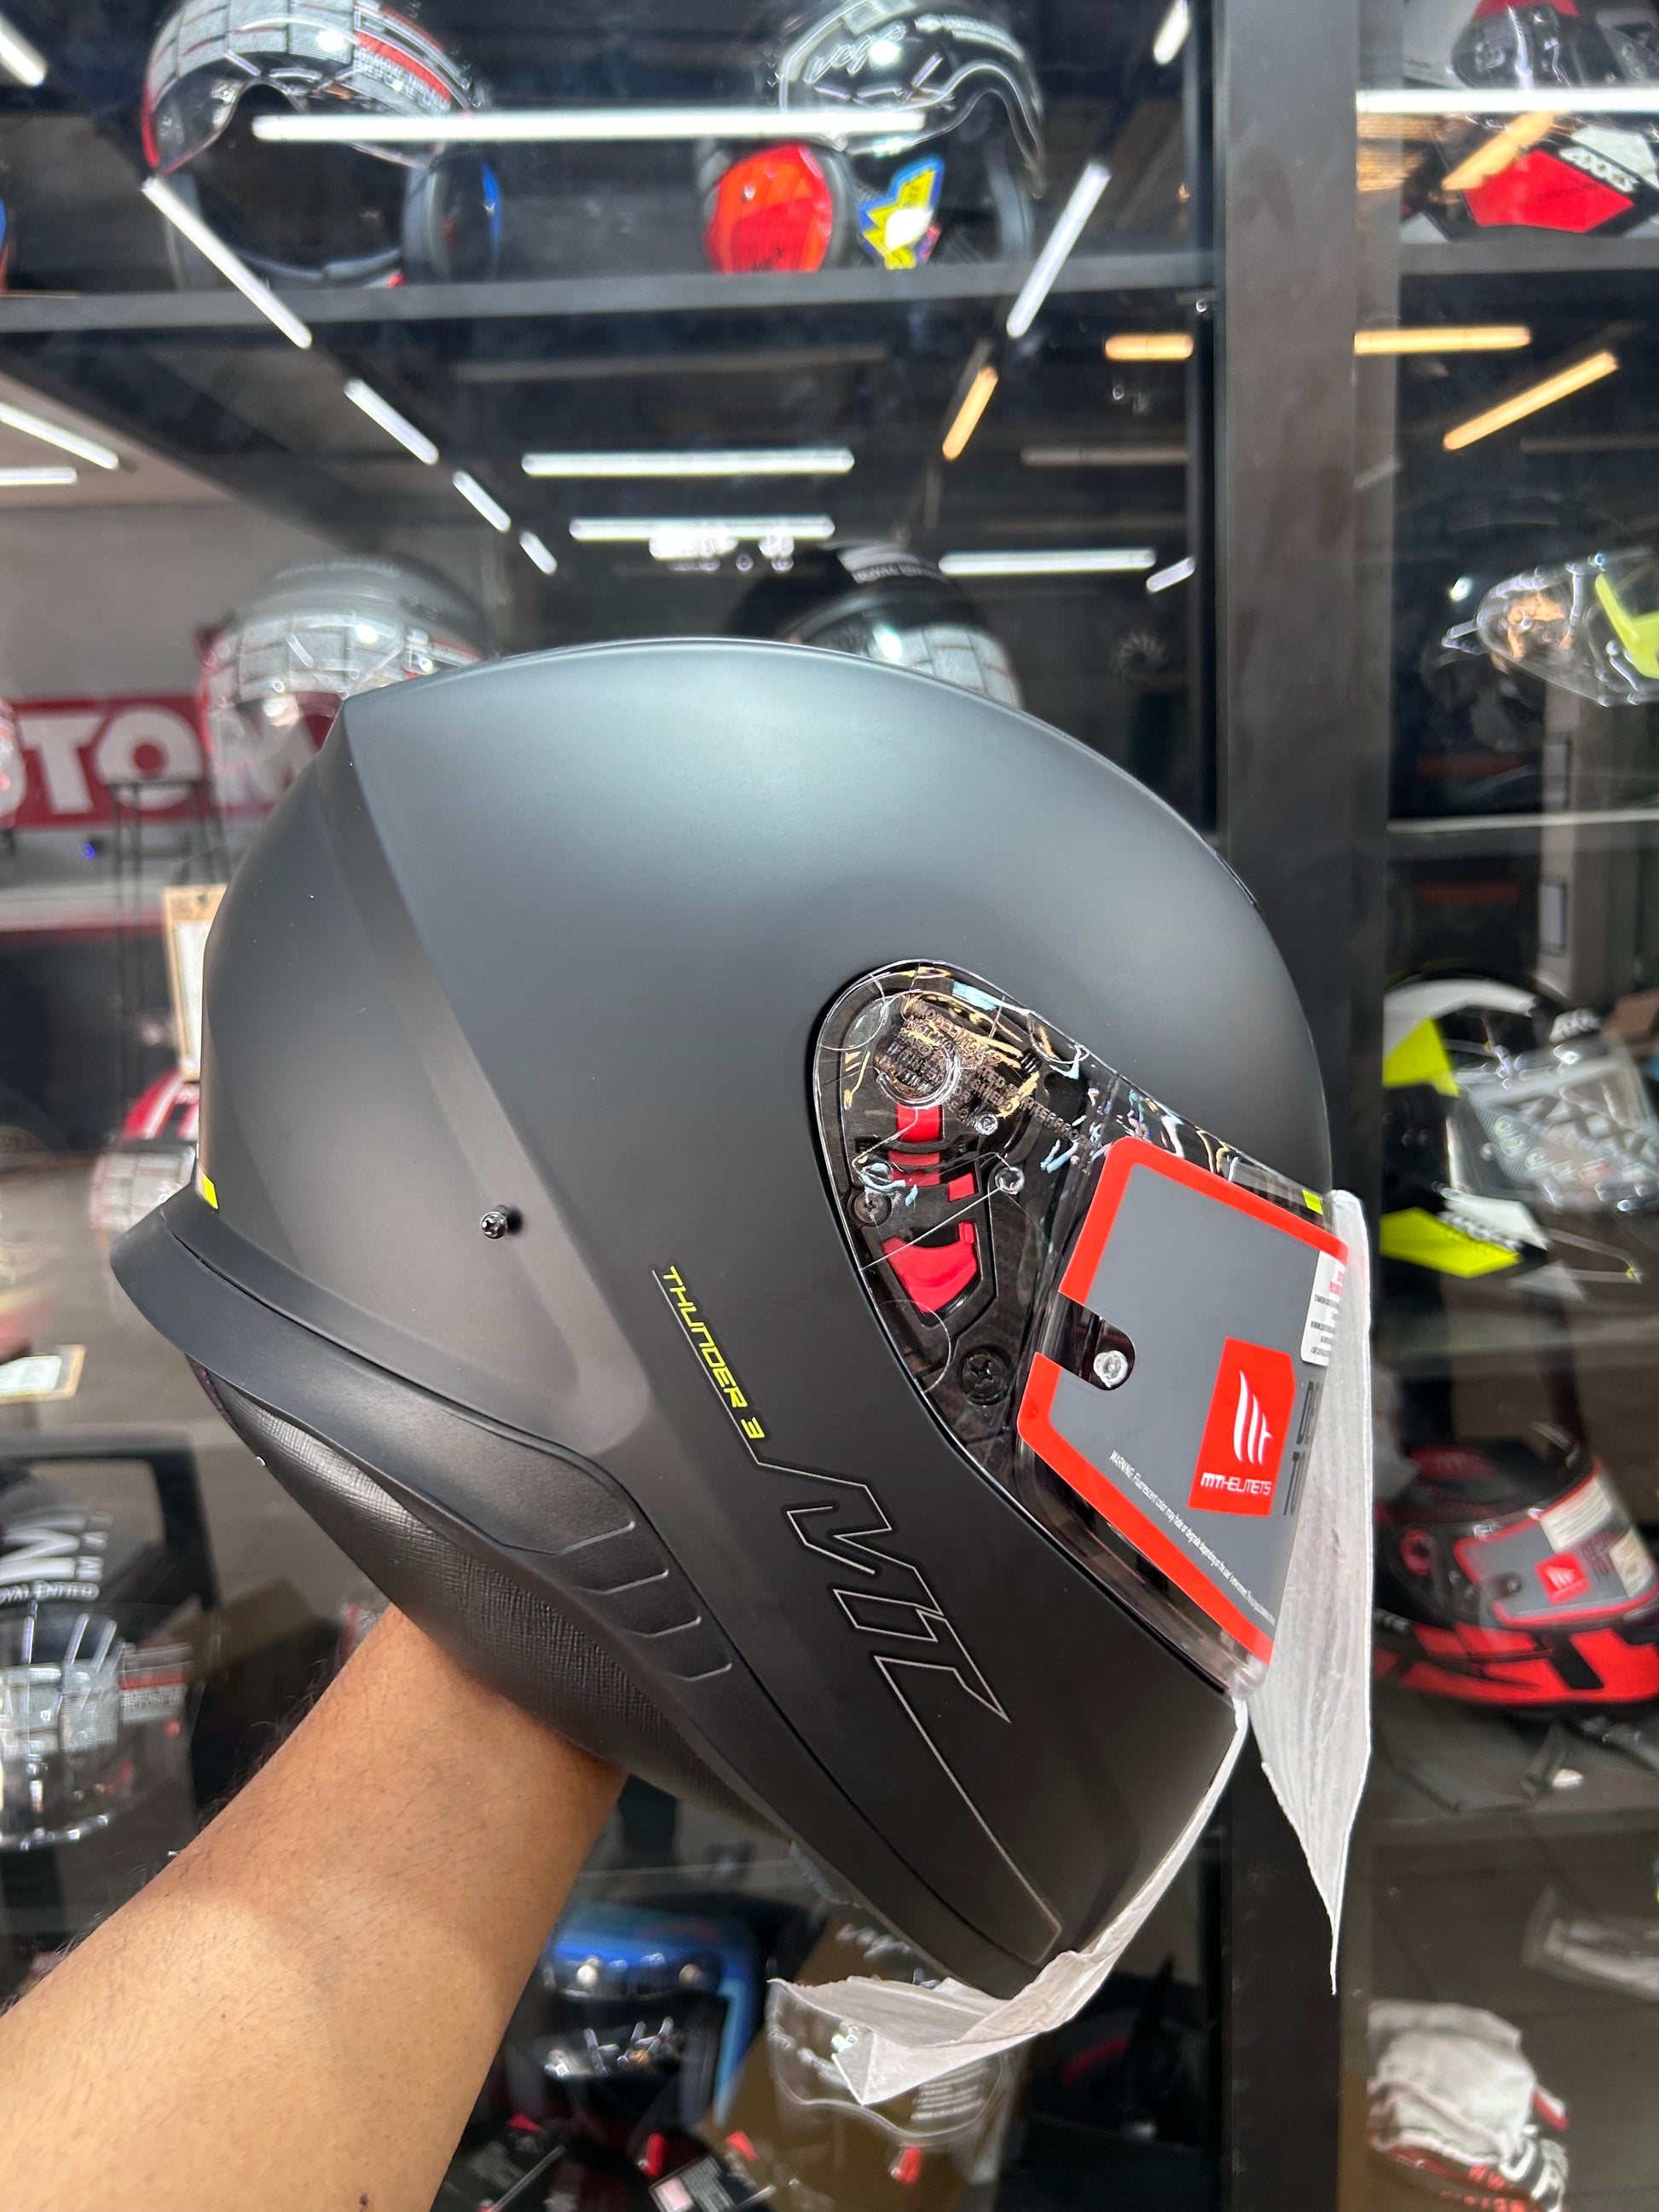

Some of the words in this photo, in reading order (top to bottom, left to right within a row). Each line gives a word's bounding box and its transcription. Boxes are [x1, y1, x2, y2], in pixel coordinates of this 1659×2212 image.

[662, 1265, 748, 1408] THUNDER
[740, 1416, 766, 1439] 3
[1132, 1472, 1159, 1504] Fluorescent
